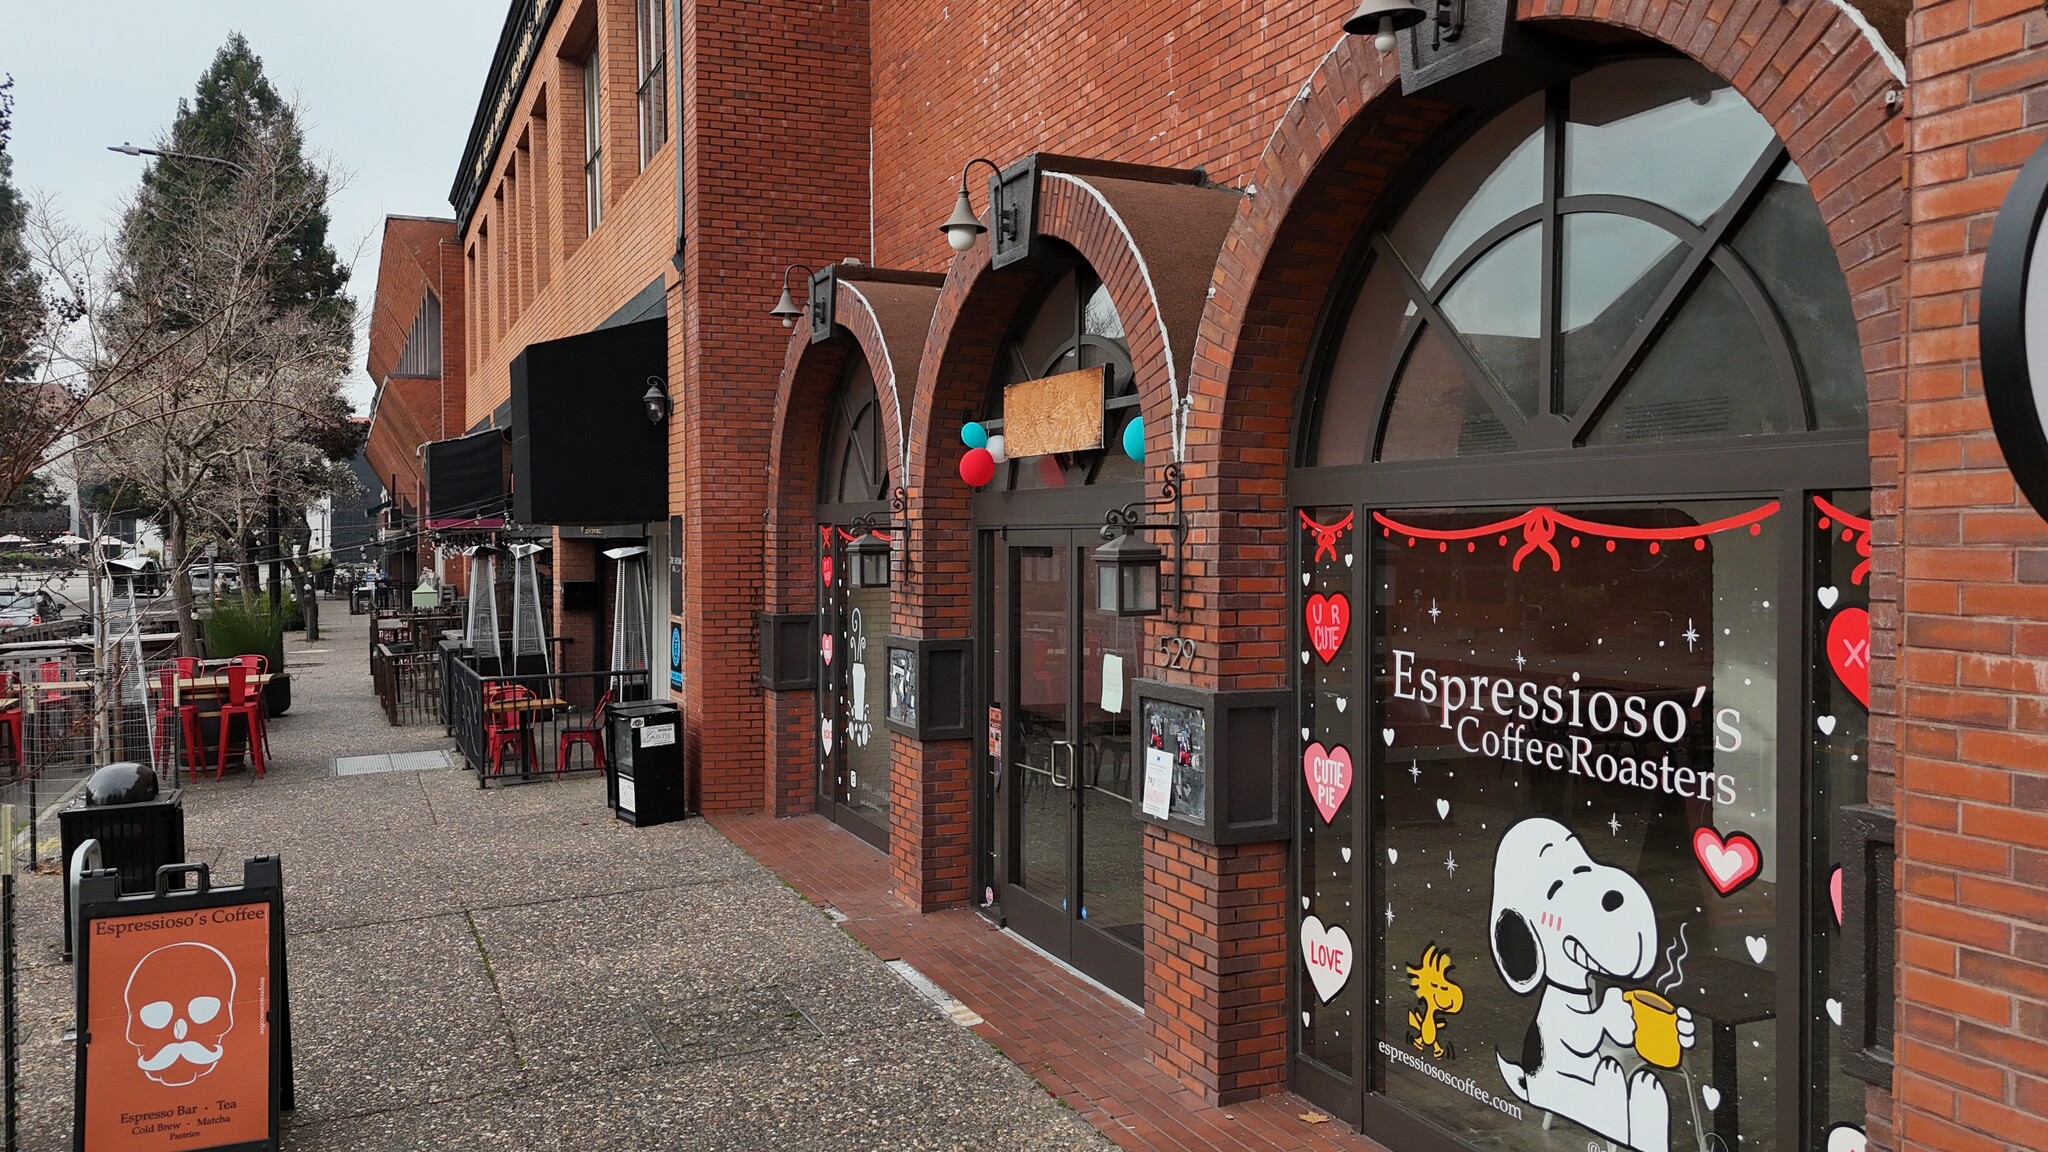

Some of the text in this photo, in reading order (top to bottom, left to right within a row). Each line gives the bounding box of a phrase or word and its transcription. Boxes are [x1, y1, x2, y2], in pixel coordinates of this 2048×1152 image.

[1312, 603, 1341, 625] U R
[1160, 636, 1195, 670] 529
[1314, 625, 1340, 651] CUTE
[1843, 638, 1870, 668] X
[1392, 649, 1743, 752] Espressioso's
[1313, 756, 1345, 789] CUTIE
[1317, 783, 1336, 809] PIE
[95, 906, 265, 938] Espressioso's Coffee
[1311, 939, 1344, 976] LOVE
[1378, 1041, 1523, 1120] espressiososcoffee.com
[120, 1100, 237, 1125] Espresso Bar Tea
[131, 1115, 231, 1135] Cold Brew Matcha
[169, 1130, 201, 1140] Pastries
